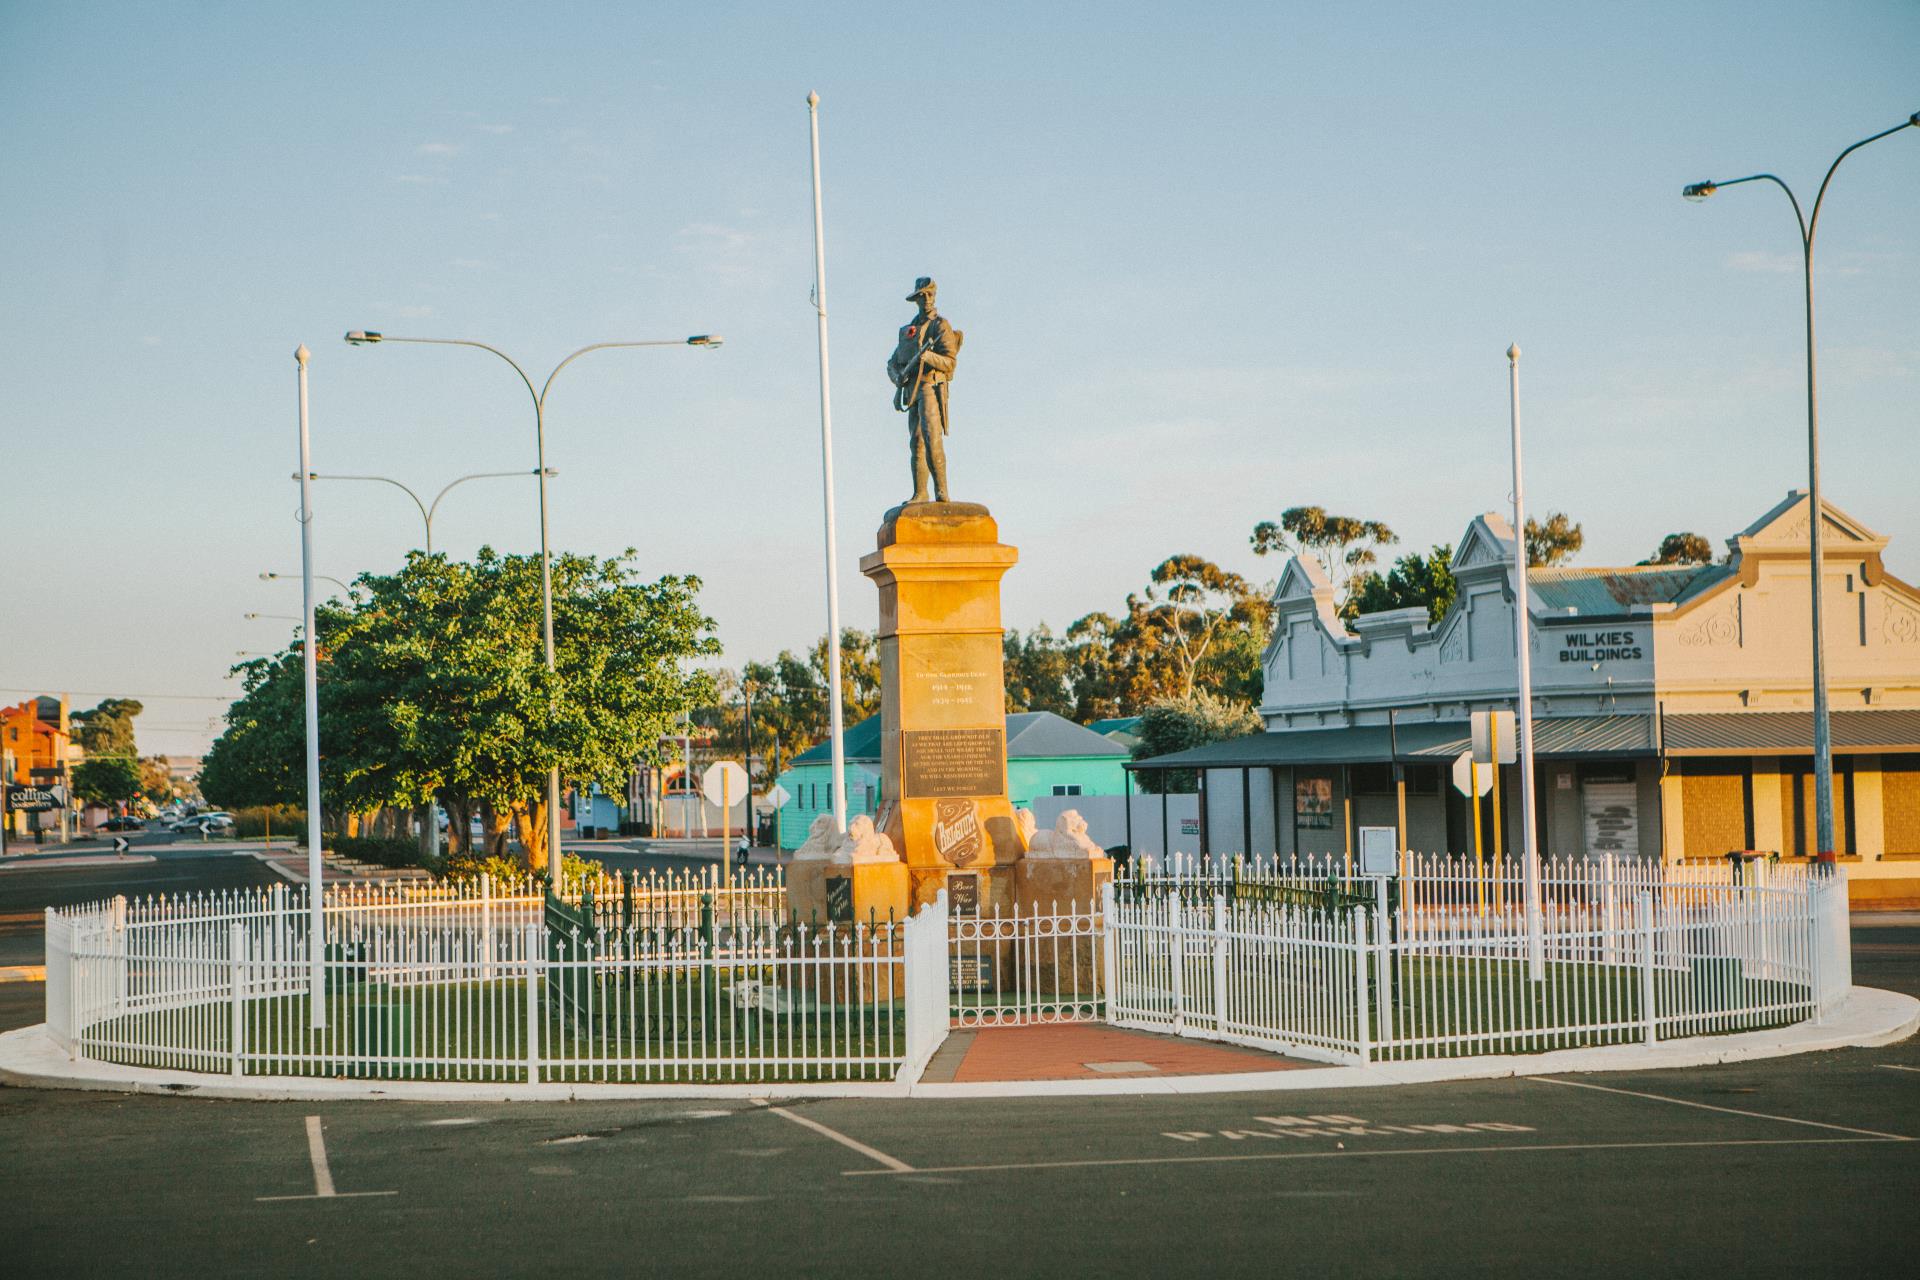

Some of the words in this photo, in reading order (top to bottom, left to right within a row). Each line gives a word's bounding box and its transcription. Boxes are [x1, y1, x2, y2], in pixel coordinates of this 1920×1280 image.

[1566, 632, 1634, 647] WILKIES
[1560, 647, 1642, 661] BUILDINGS
[11, 787, 51, 801] collins
[1253, 1114, 1369, 1126] NO
[1160, 1123, 1537, 1142] PARKING
